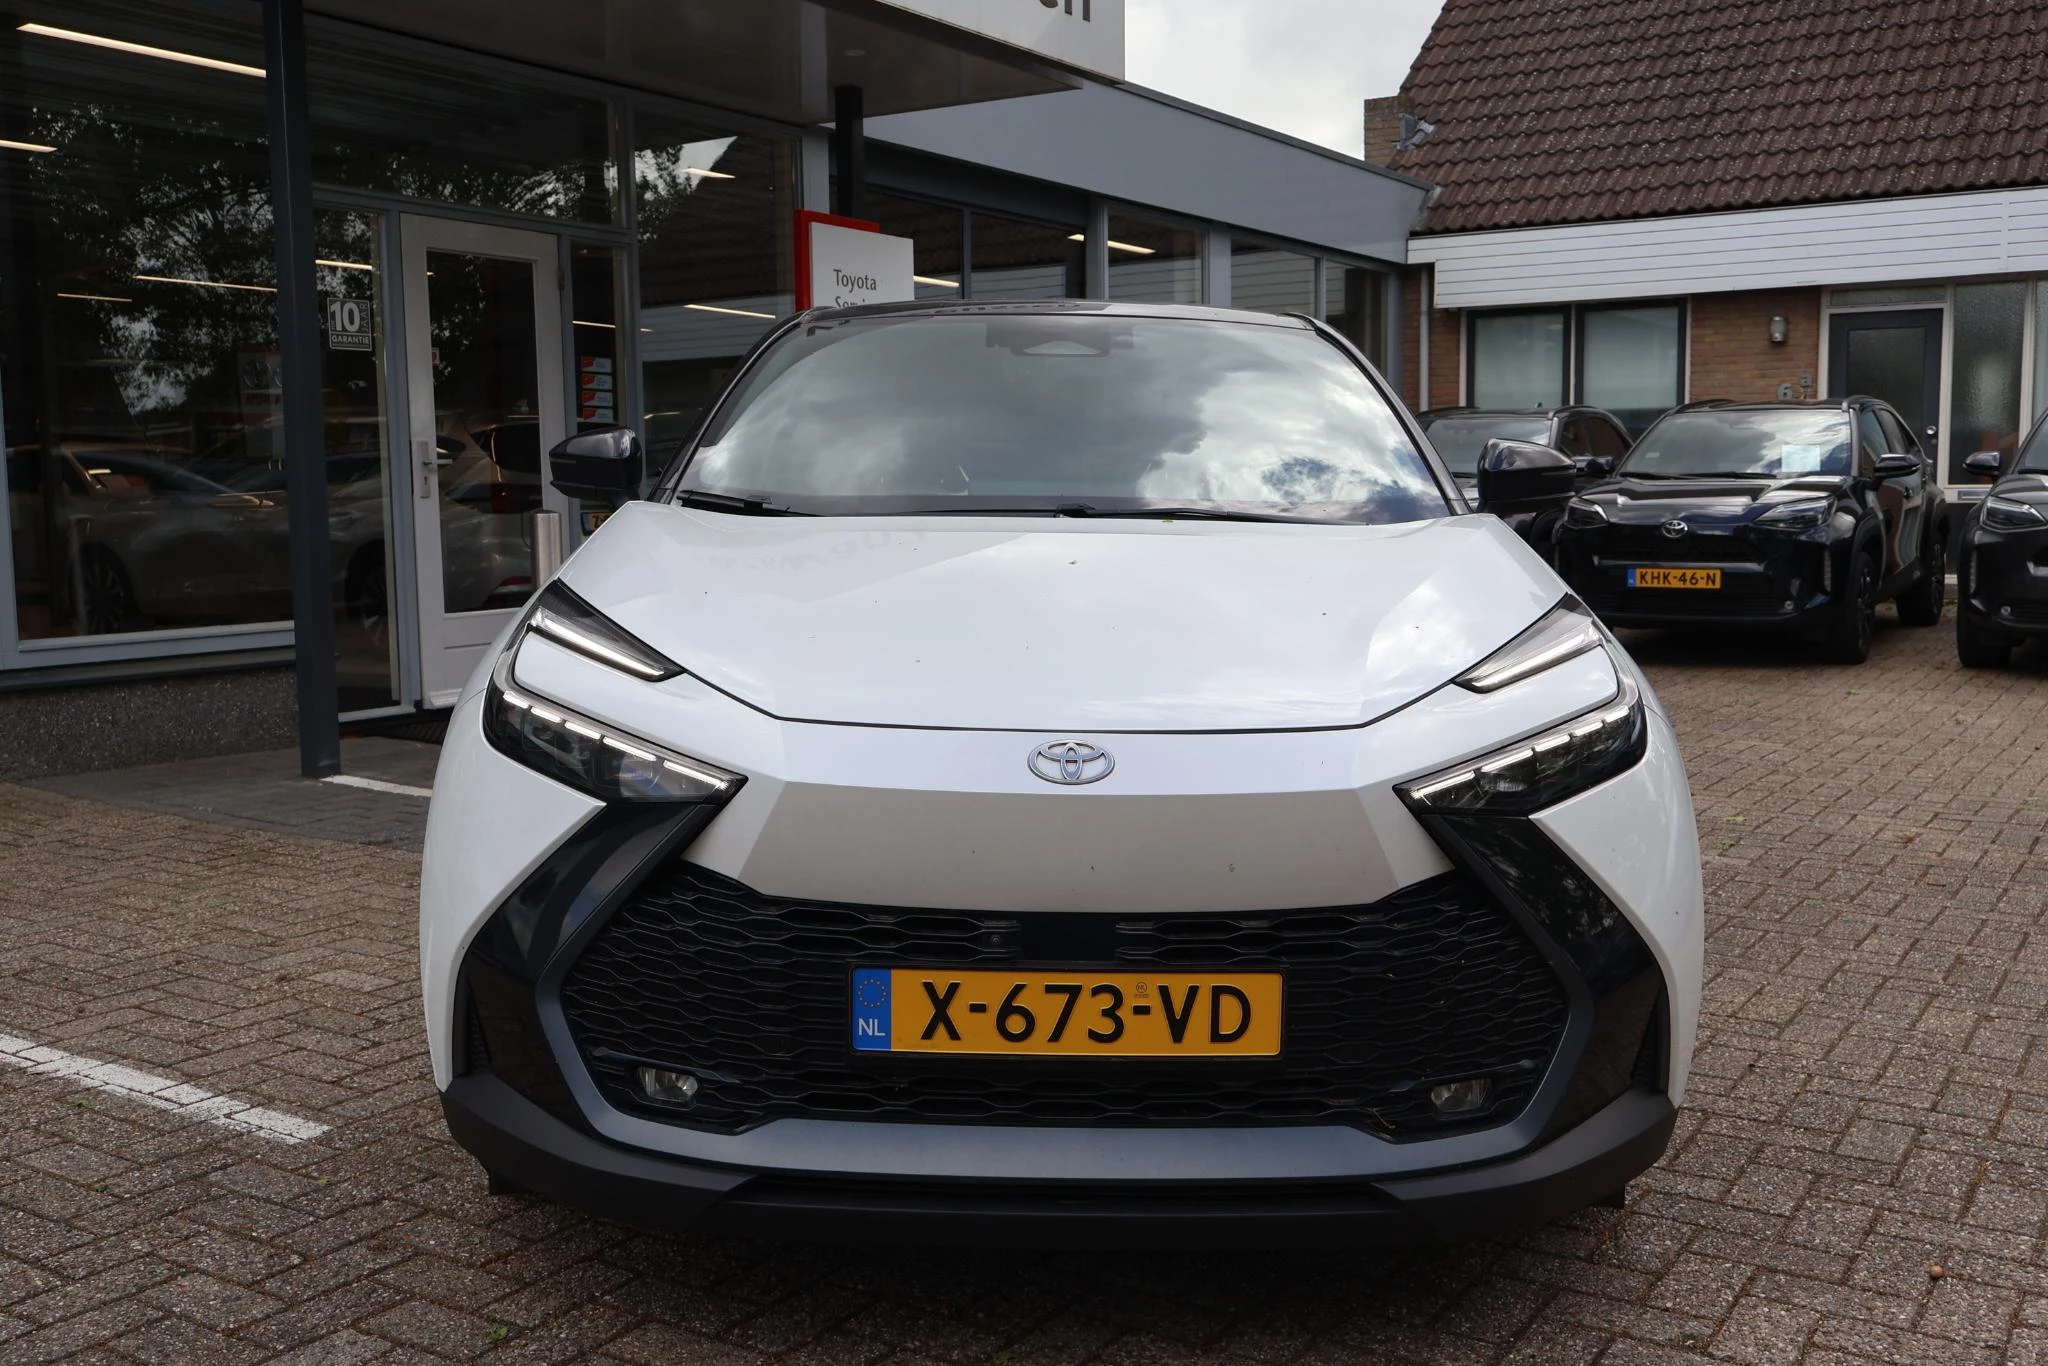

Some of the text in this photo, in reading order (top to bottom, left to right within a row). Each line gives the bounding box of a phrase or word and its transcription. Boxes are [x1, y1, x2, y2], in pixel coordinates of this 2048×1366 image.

[833, 269, 877, 293] Toyota
[330, 301, 361, 332] 10
[360, 303, 369, 331] JAAR
[331, 335, 369, 344] GARANTIE
[1639, 570, 1717, 586] KHK-46-N
[920, 979, 1252, 1044] X-673-VD
[858, 1018, 887, 1037] NL
